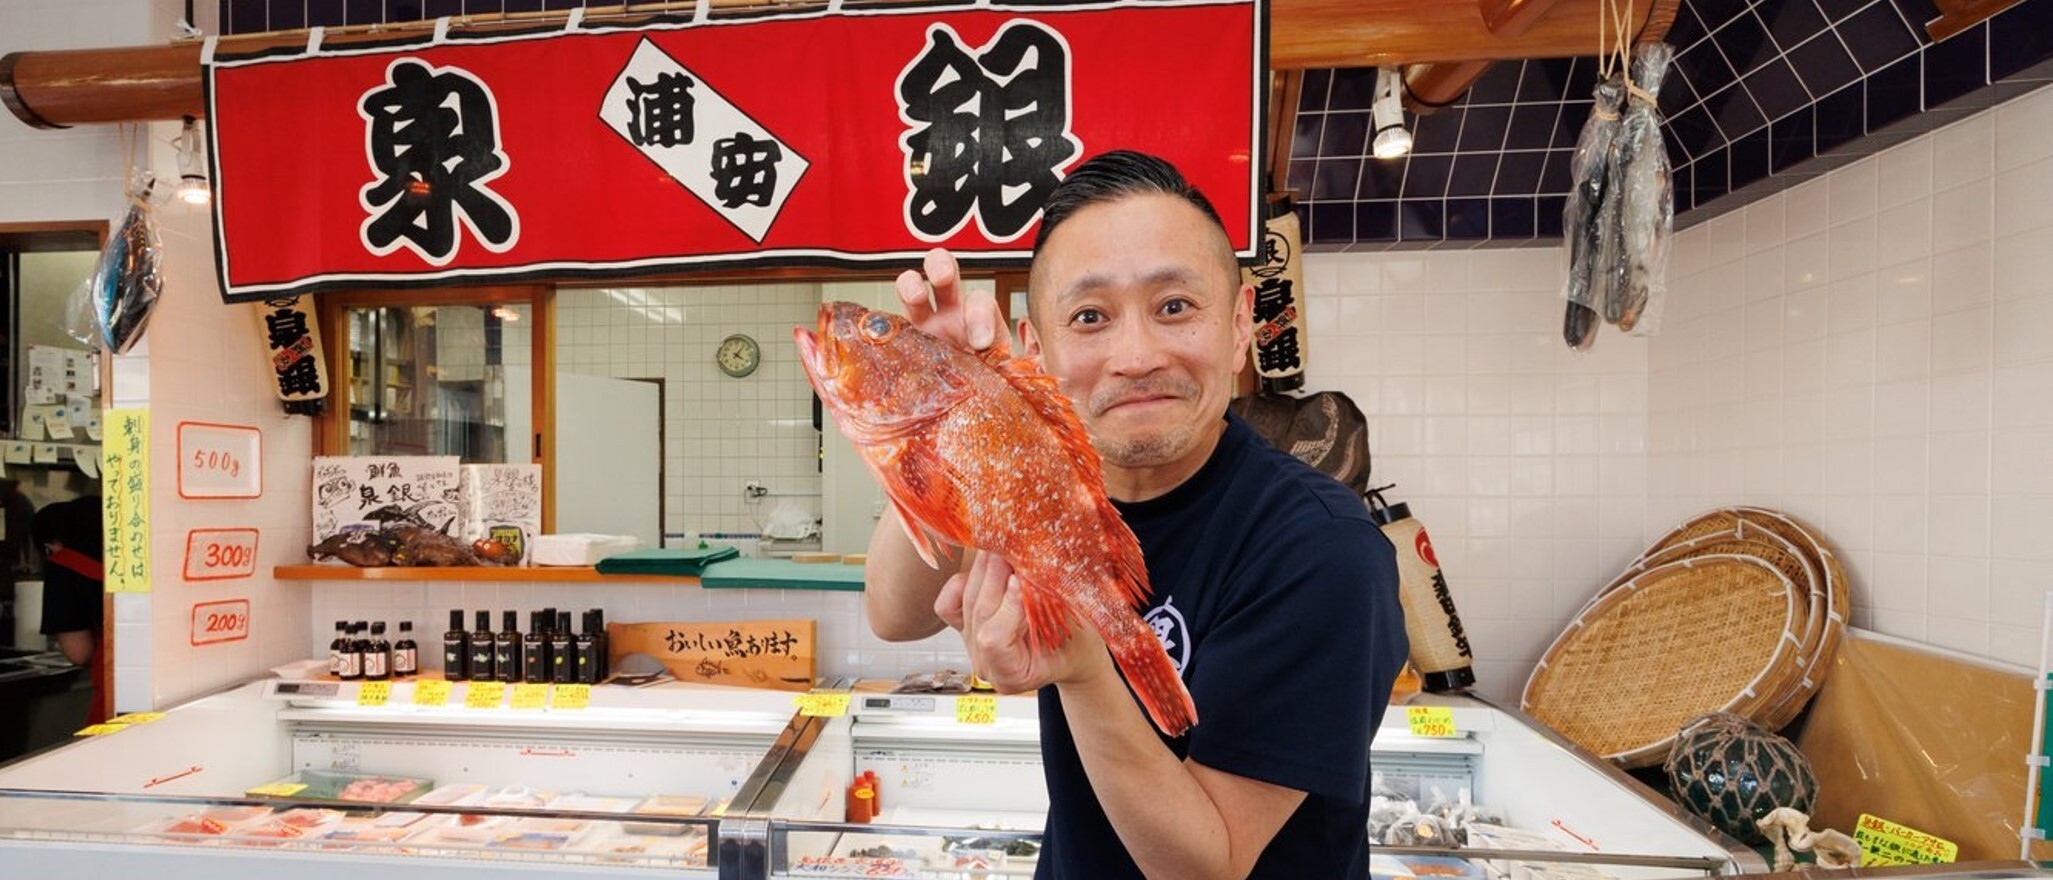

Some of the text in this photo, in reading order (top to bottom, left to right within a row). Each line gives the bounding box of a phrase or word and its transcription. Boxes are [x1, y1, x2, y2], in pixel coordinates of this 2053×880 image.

[194, 449, 241, 478] 500g
[123, 415, 146, 579] 刺身の盛り合わせは
[204, 542, 252, 568] 300g
[205, 613, 247, 632] 200g
[664, 628, 799, 662] おいしい魚あります。
